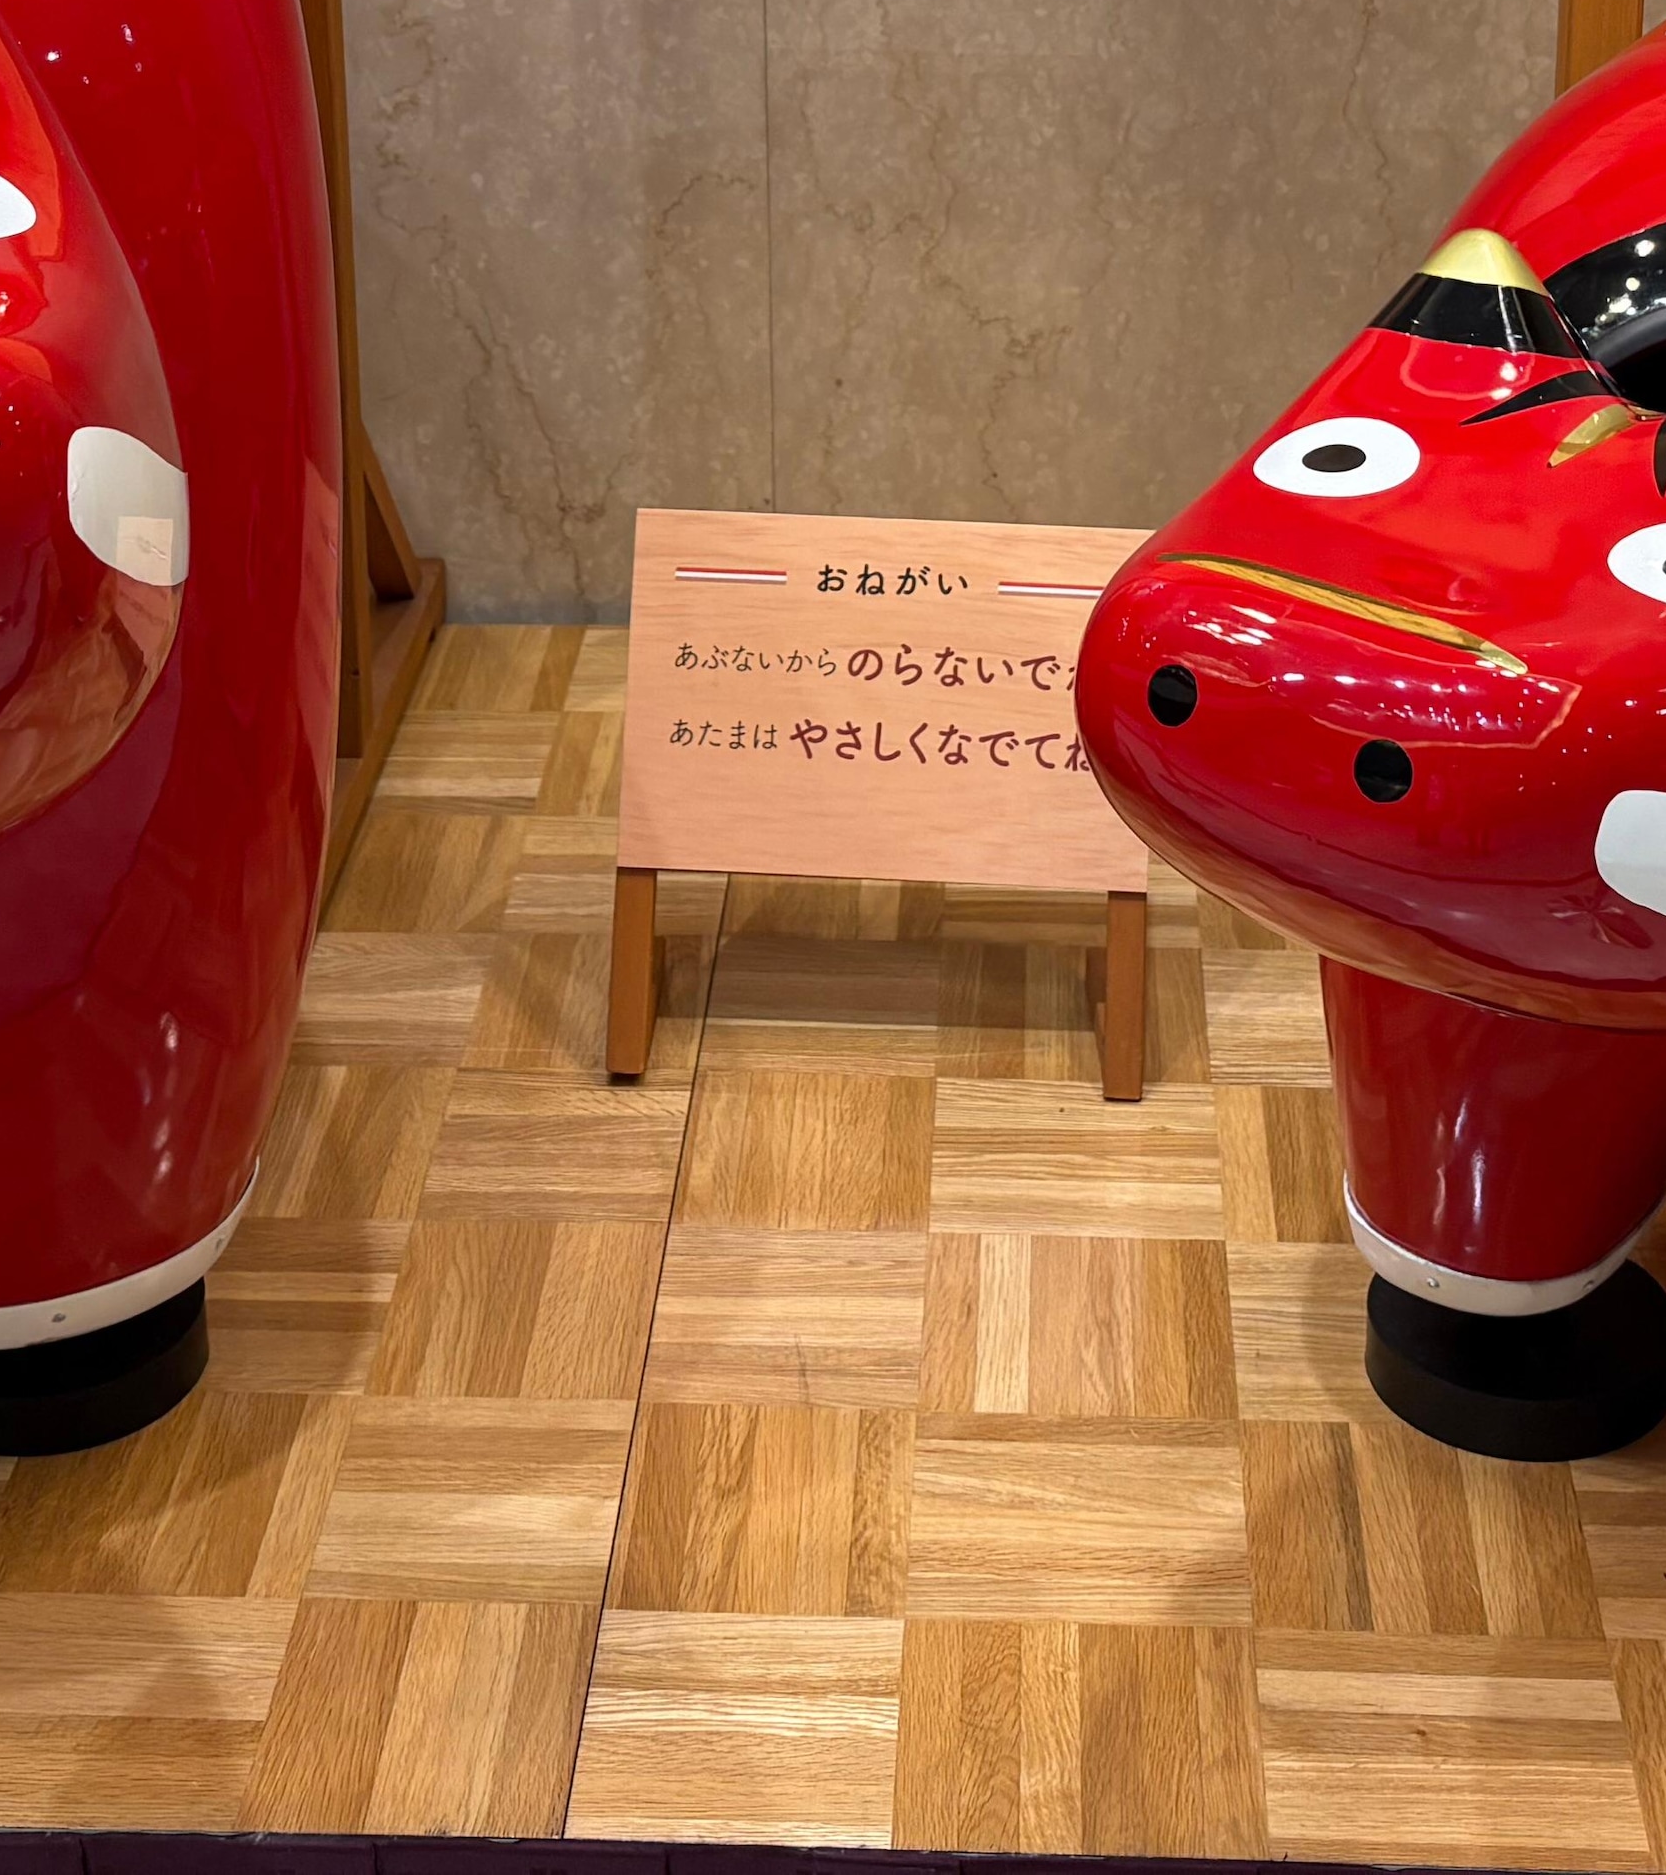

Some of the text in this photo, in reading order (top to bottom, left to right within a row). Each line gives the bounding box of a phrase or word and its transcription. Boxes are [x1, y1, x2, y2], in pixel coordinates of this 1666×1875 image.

[816, 563, 970, 597] おねがい
[673, 642, 837, 677] あぶないから
[669, 719, 779, 751] あたまは
